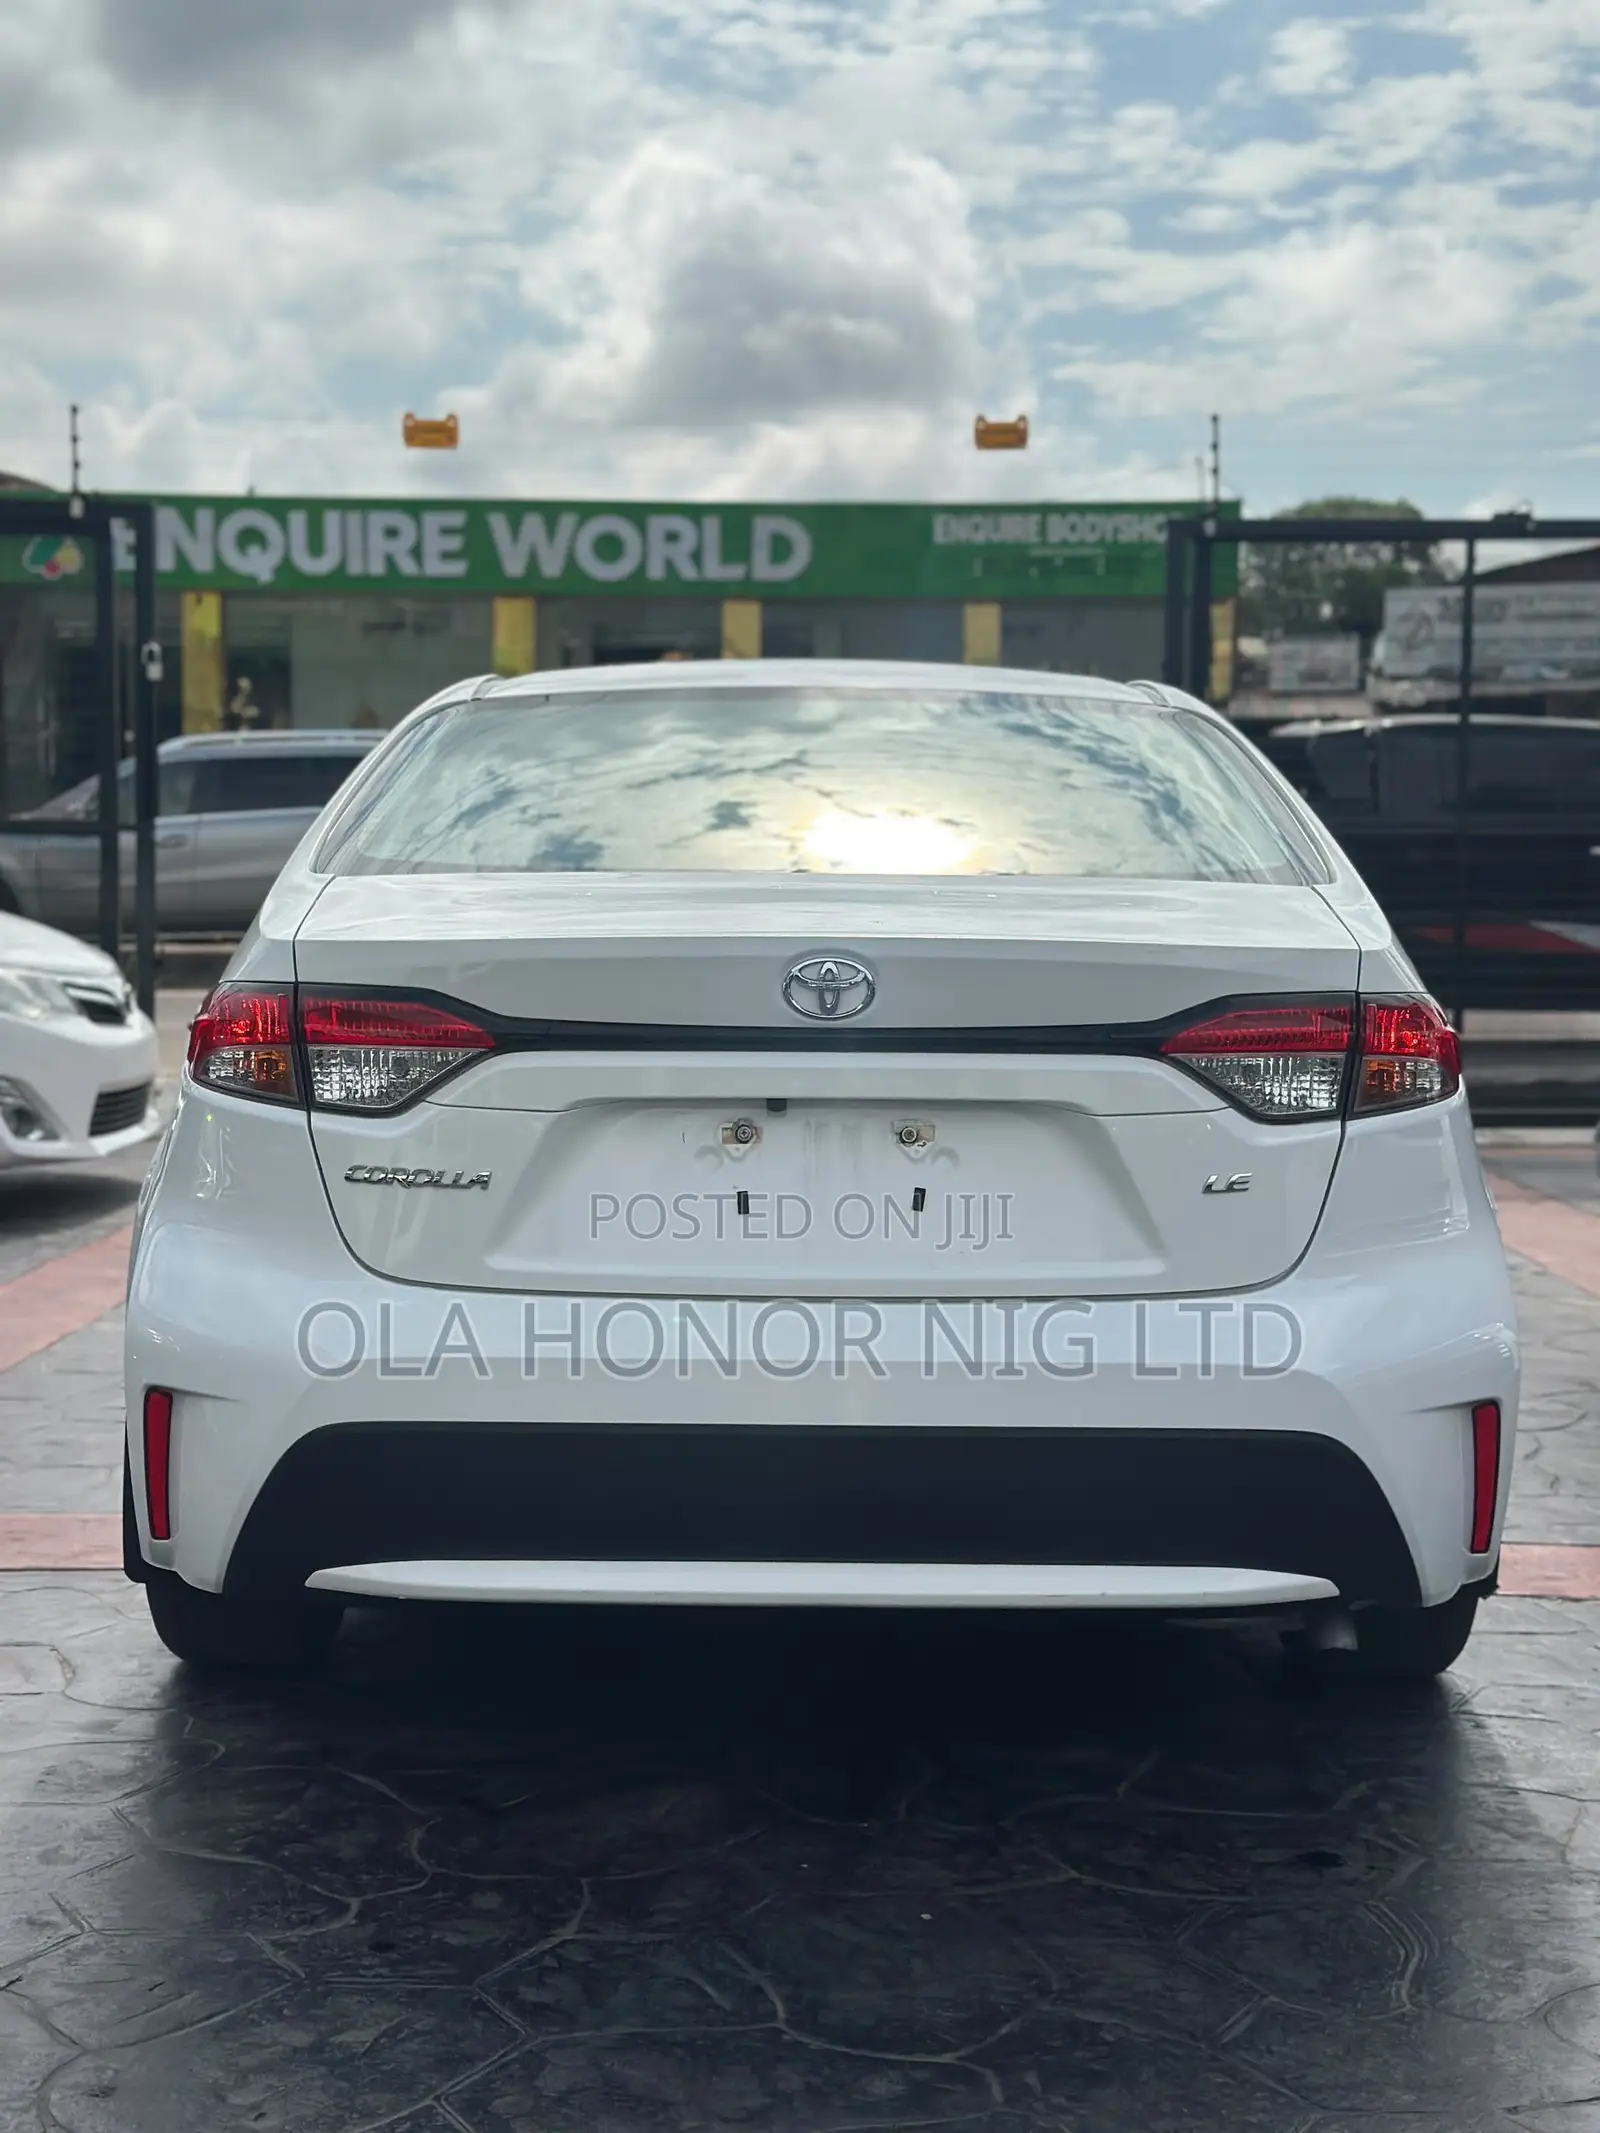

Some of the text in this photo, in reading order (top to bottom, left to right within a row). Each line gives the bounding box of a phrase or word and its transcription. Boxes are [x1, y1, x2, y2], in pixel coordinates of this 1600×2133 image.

[933, 511, 1180, 545] ENQUIRE BODYSHO
[487, 511, 812, 582] WORLD
[344, 1165, 492, 1191] COROLLA
[1202, 1172, 1253, 1195] LE
